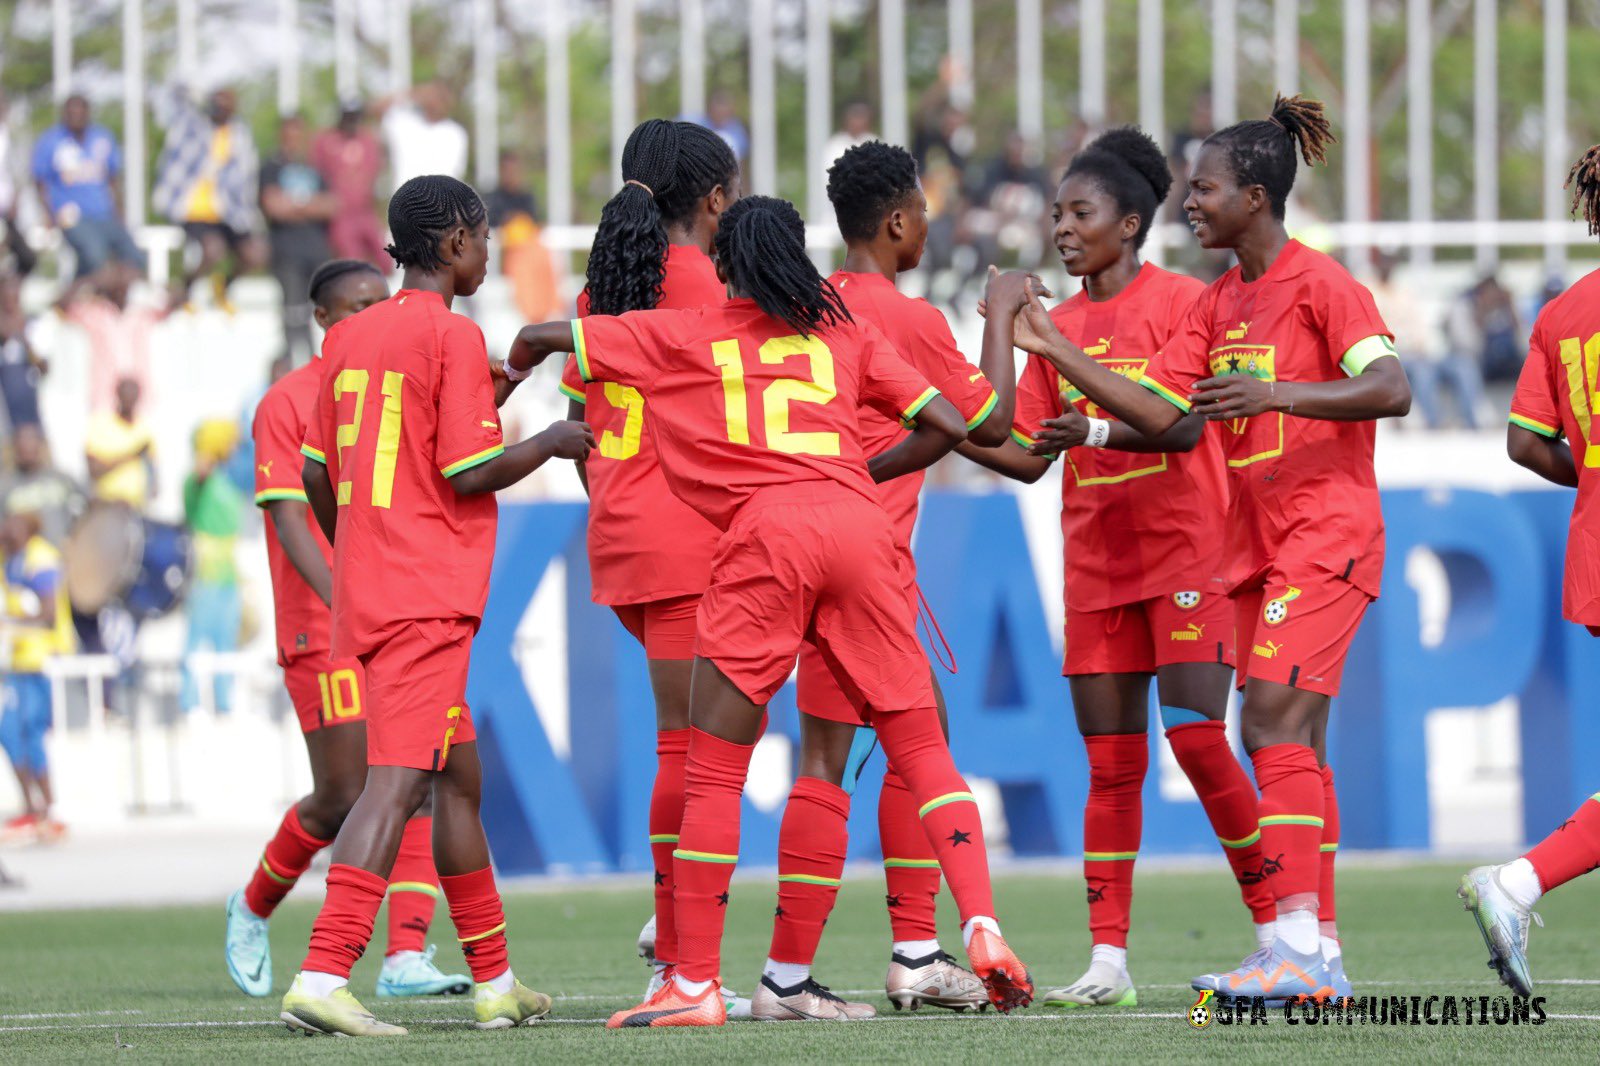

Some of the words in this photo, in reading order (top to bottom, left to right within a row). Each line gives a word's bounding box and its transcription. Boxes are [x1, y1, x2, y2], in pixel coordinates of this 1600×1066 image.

[712, 333, 841, 456] 12
[333, 369, 405, 509] 21
[1171, 630, 1198, 641] PUMA
[1253, 644, 1273, 659] PUMA
[318, 668, 361, 721] 10
